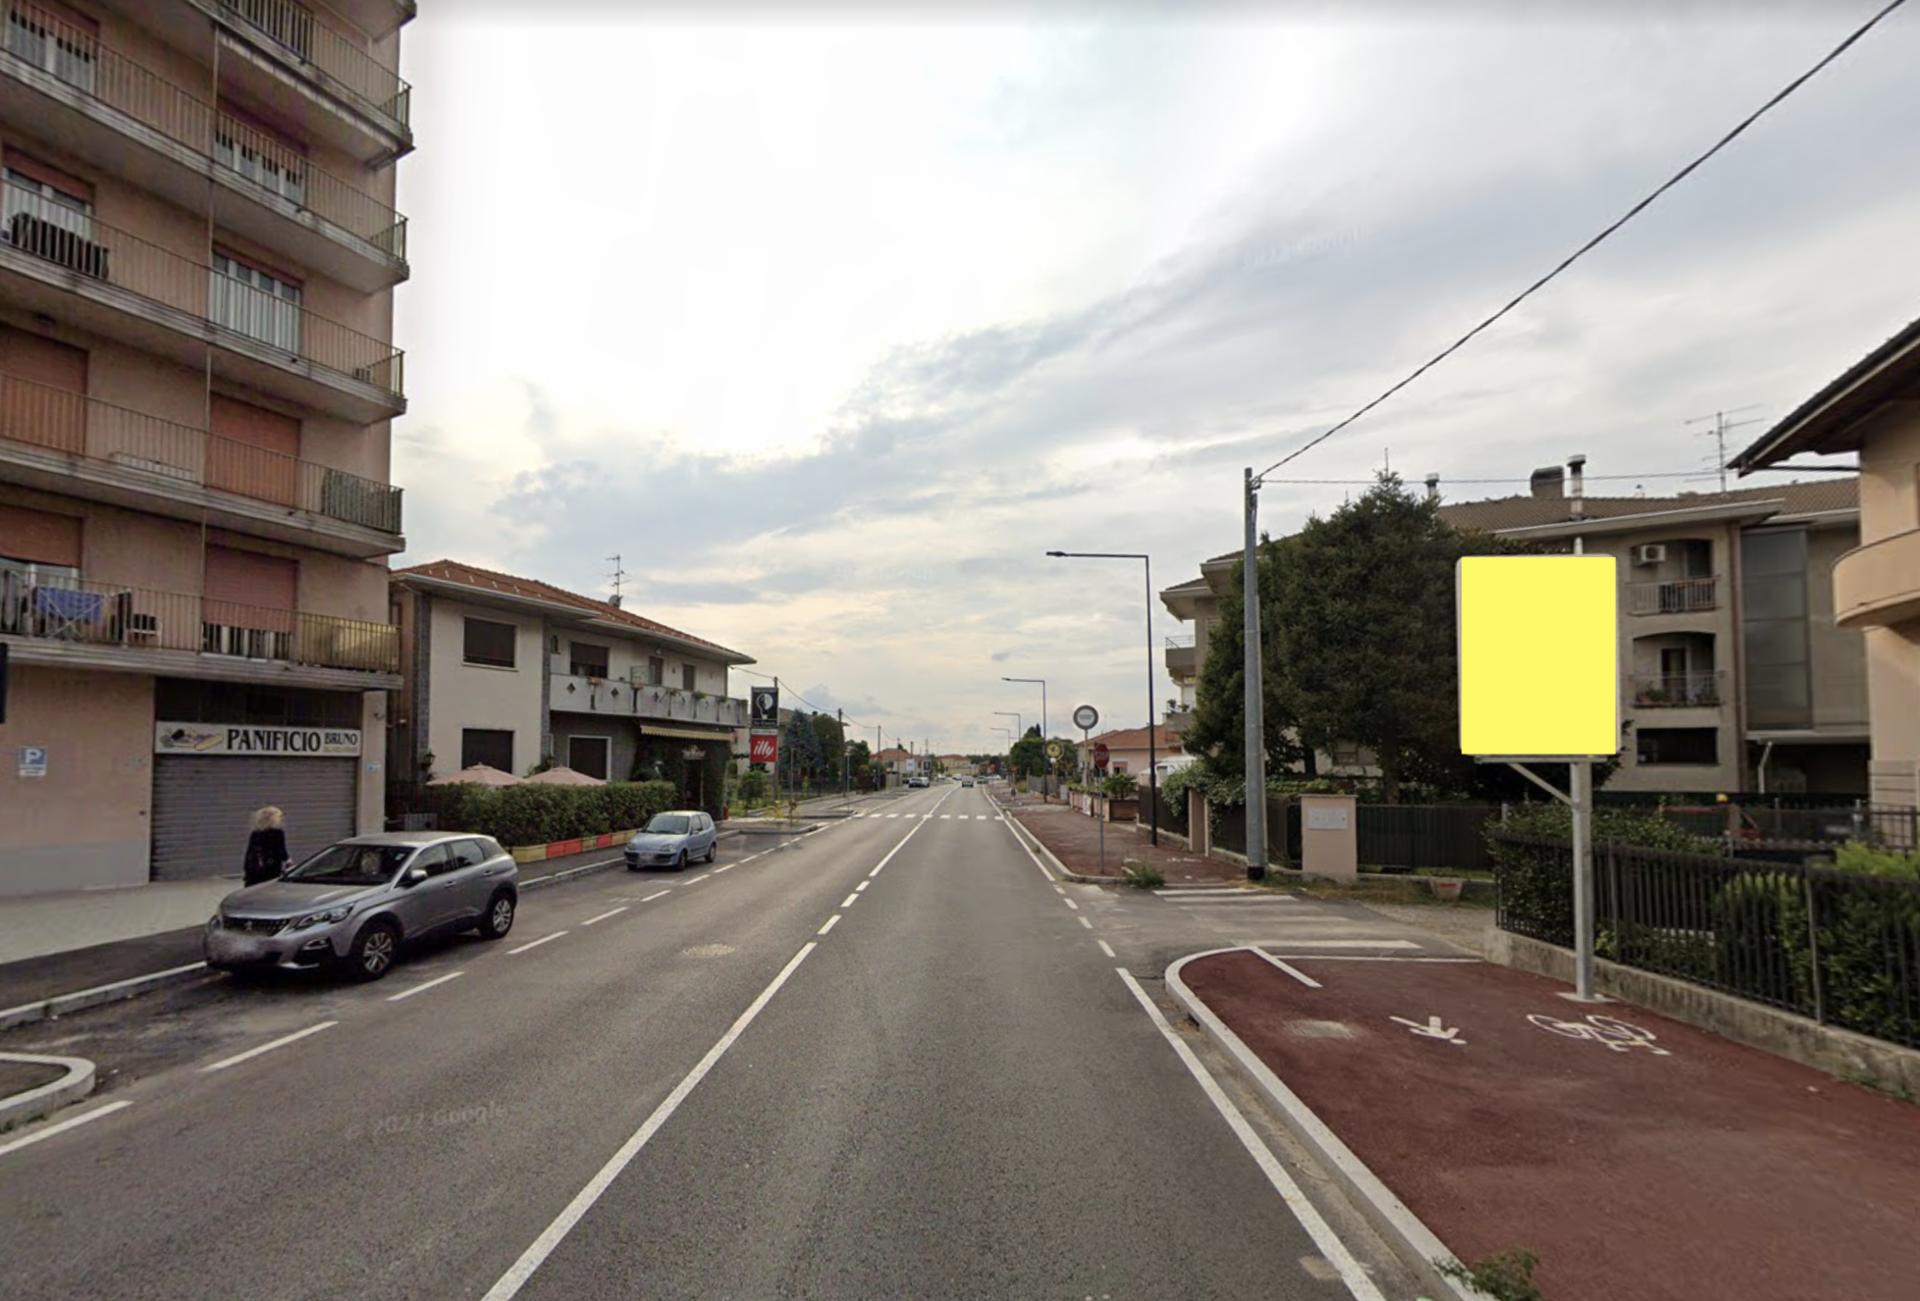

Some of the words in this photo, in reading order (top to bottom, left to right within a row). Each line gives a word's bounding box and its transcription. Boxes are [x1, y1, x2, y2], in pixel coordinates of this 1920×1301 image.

[227, 729, 320, 752] PANIFICIO
[324, 732, 358, 745] BRUNO
[753, 740, 775, 759] illy
[25, 748, 42, 763] P
